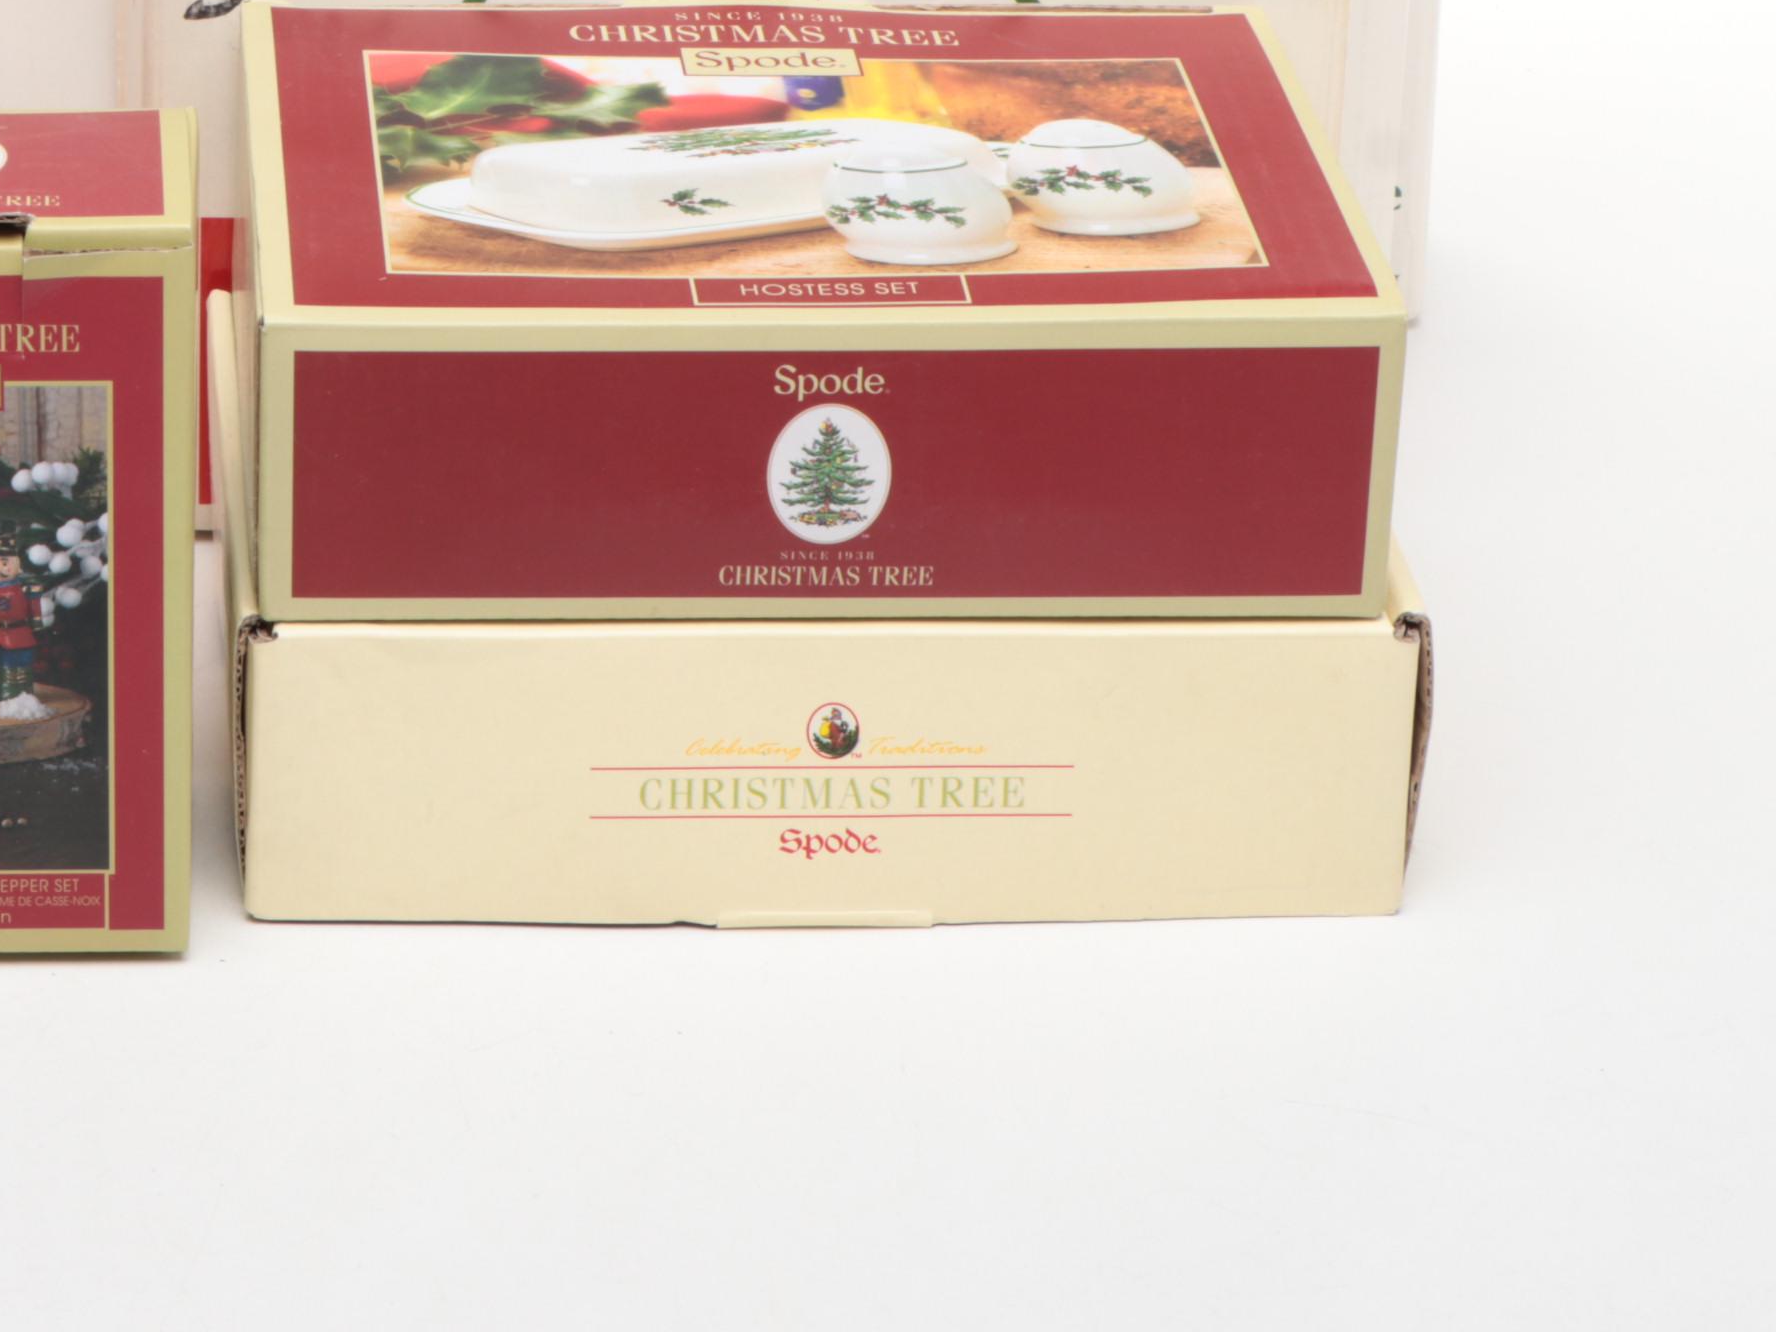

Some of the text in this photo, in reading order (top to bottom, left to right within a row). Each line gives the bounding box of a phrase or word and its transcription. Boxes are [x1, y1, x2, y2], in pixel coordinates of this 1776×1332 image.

[674, 11, 844, 23] SINCE 1938
[568, 24, 961, 46] CHRISTMAS TREE
[739, 281, 919, 297] HOSTESS SET
[780, 549, 875, 561] SINCE 1938
[718, 565, 934, 587] CHRISTMAS TREE
[685, 737, 987, 761] Celebrating Traditions
[639, 776, 1026, 812] CHRISTMAS TREE
[778, 827, 881, 861] Spode
[53, 878, 80, 893] SET
[18, 896, 32, 907] DE
